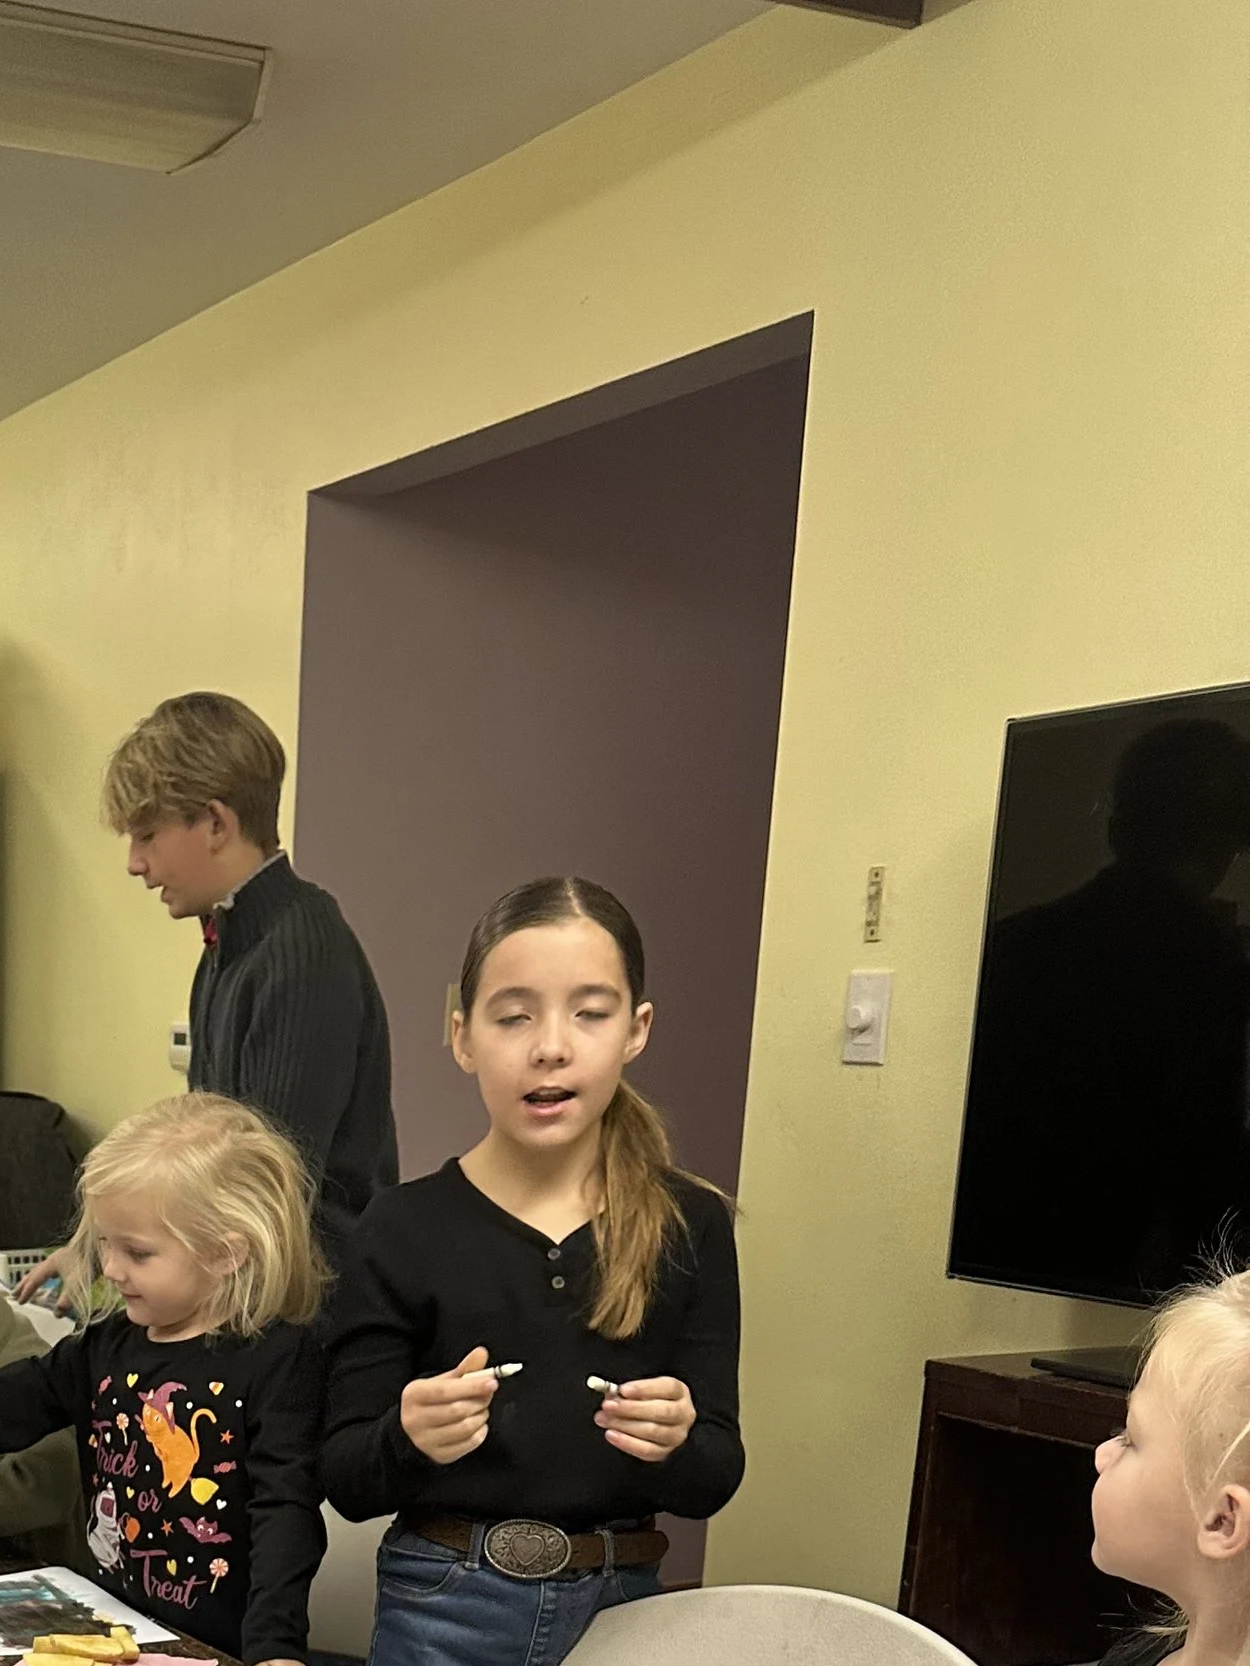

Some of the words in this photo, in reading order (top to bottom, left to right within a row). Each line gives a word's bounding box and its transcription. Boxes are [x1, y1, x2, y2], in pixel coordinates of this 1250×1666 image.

[92, 1419, 139, 1478] Trick
[137, 1489, 162, 1513] or
[130, 1549, 207, 1609] Treat
